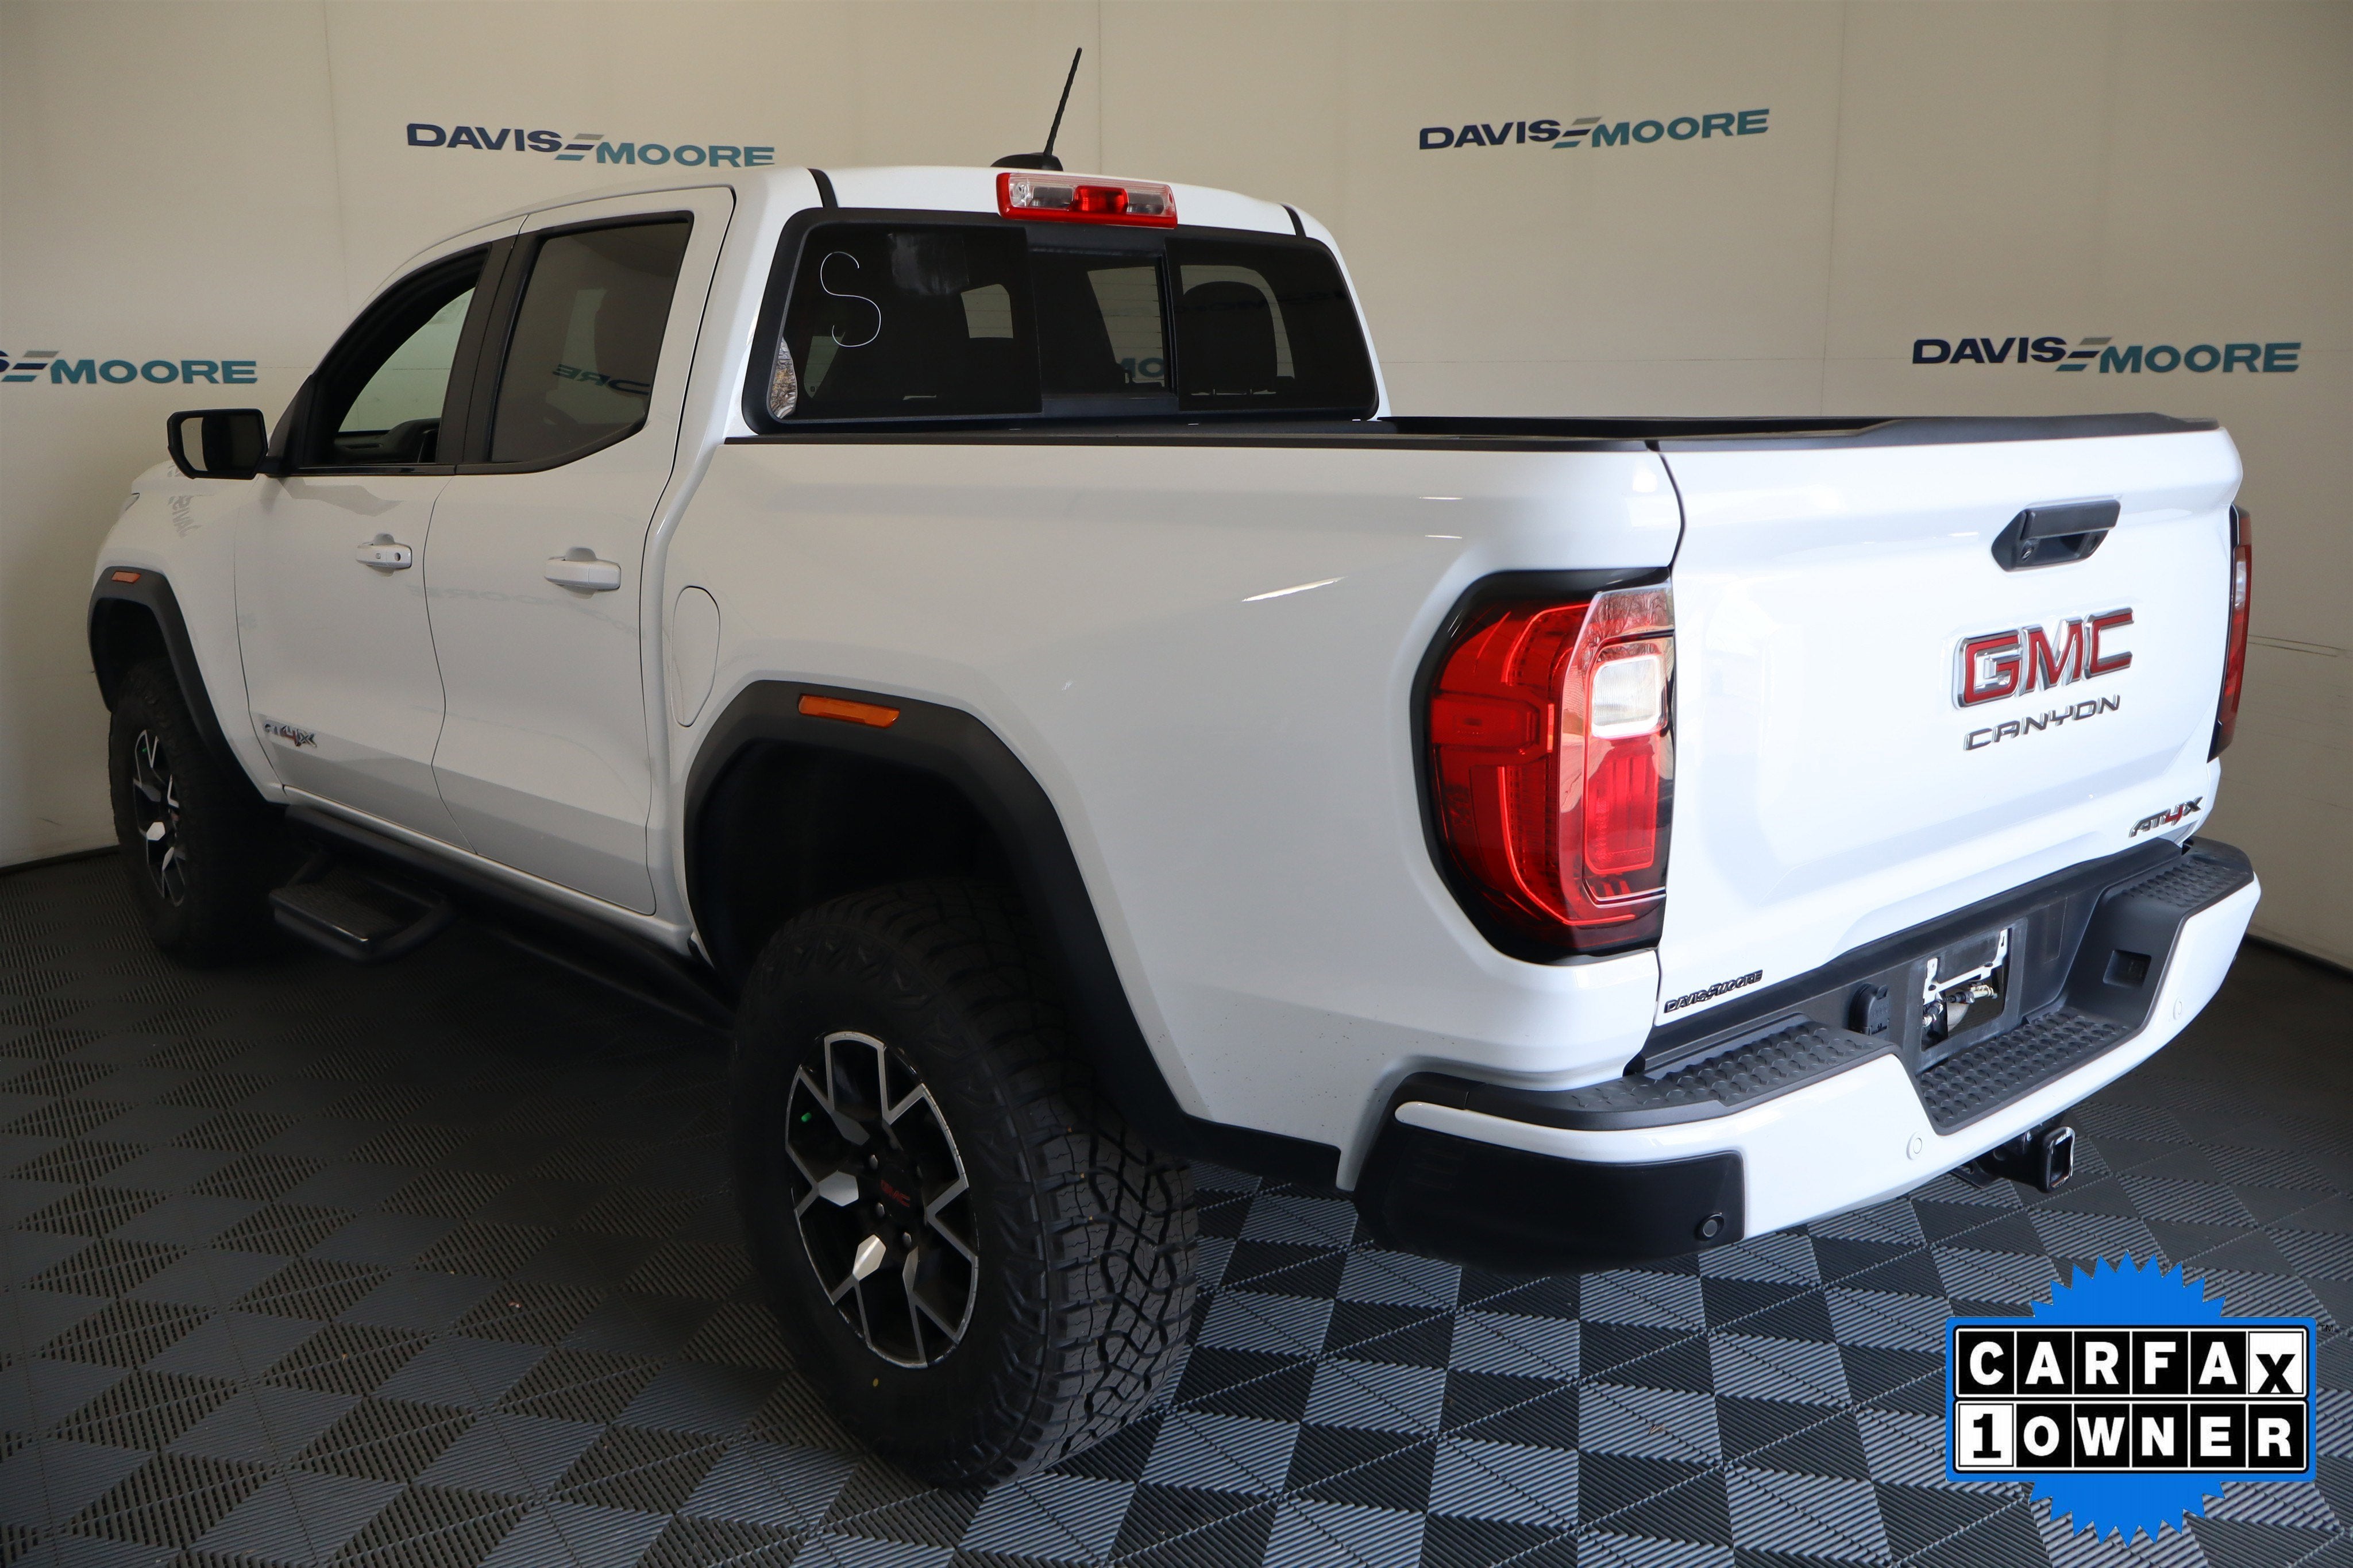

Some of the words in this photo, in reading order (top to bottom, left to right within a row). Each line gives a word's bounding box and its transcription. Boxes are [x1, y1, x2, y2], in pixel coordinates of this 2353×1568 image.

[407, 123, 562, 152] DAVIS
[596, 142, 775, 167] MOORE
[1419, 119, 1562, 150] DAVIS
[1591, 109, 1770, 148] MOORE
[820, 251, 881, 347] S
[50, 359, 257, 384] MOORE
[1912, 337, 2067, 364] DAVIS
[2099, 342, 2301, 373] MOORE
[1954, 607, 2135, 710] GMC
[1964, 693, 2121, 751] CANYON
[2128, 796, 2203, 838] AT4X
[1664, 989, 1708, 1014] DAVIS
[1716, 970, 1763, 997] MOORE
[881, 1179, 911, 1208] GMC
